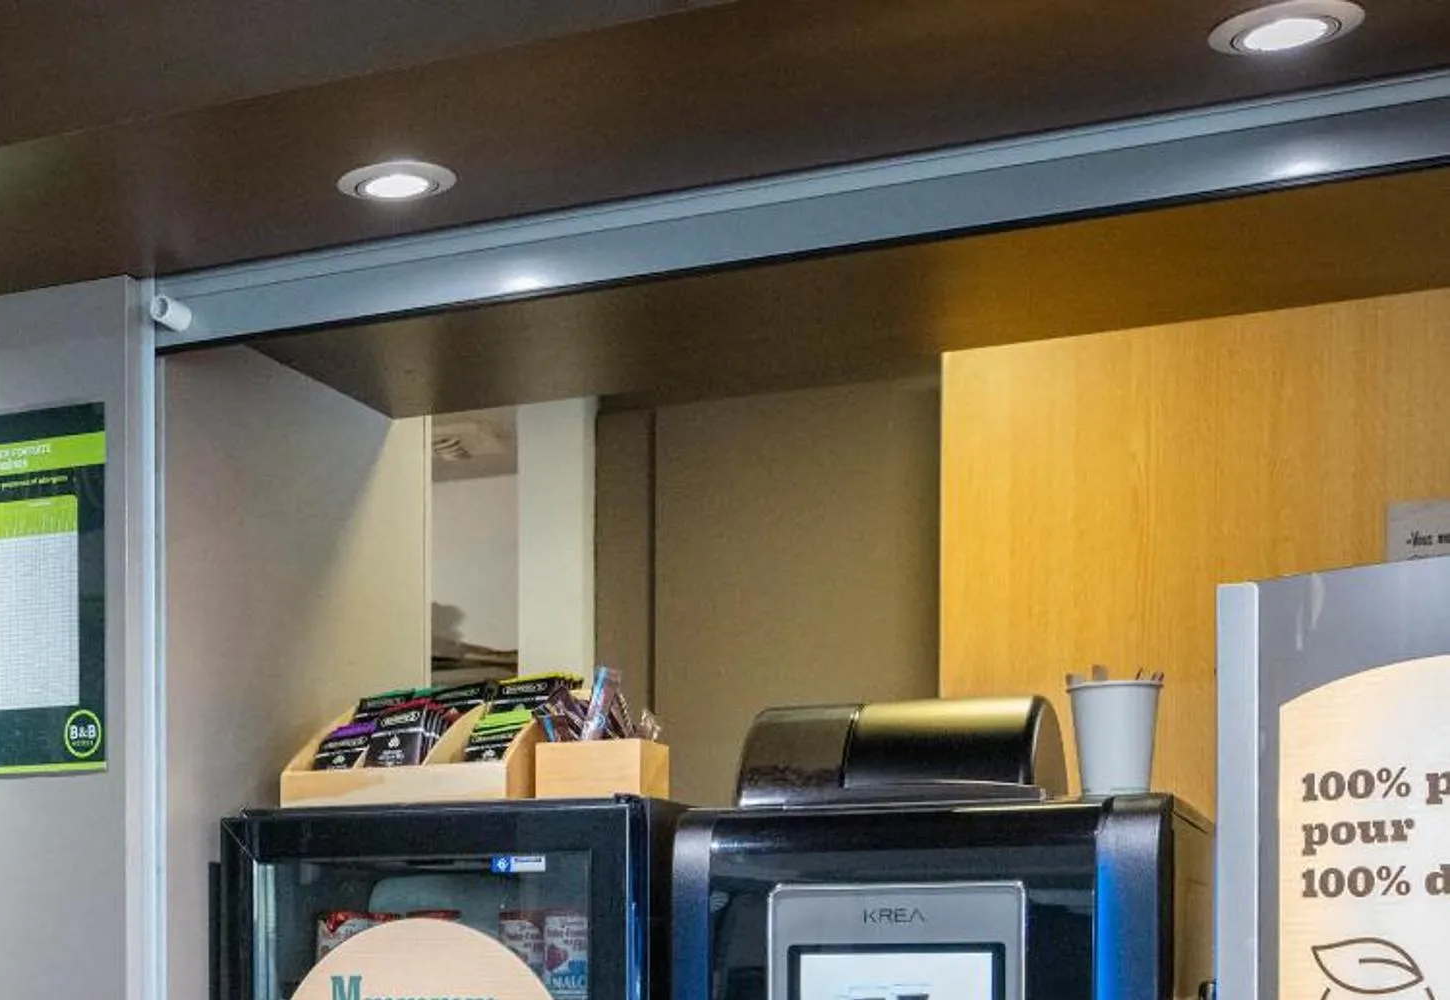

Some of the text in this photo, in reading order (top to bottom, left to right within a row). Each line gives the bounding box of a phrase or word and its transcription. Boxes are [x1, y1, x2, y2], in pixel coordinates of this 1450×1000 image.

[70, 724, 97, 740] B&B
[1302, 767, 1411, 802] 100%
[1302, 818, 1415, 856] pour
[1302, 865, 1411, 898] 100%
[863, 907, 925, 924] KREA
